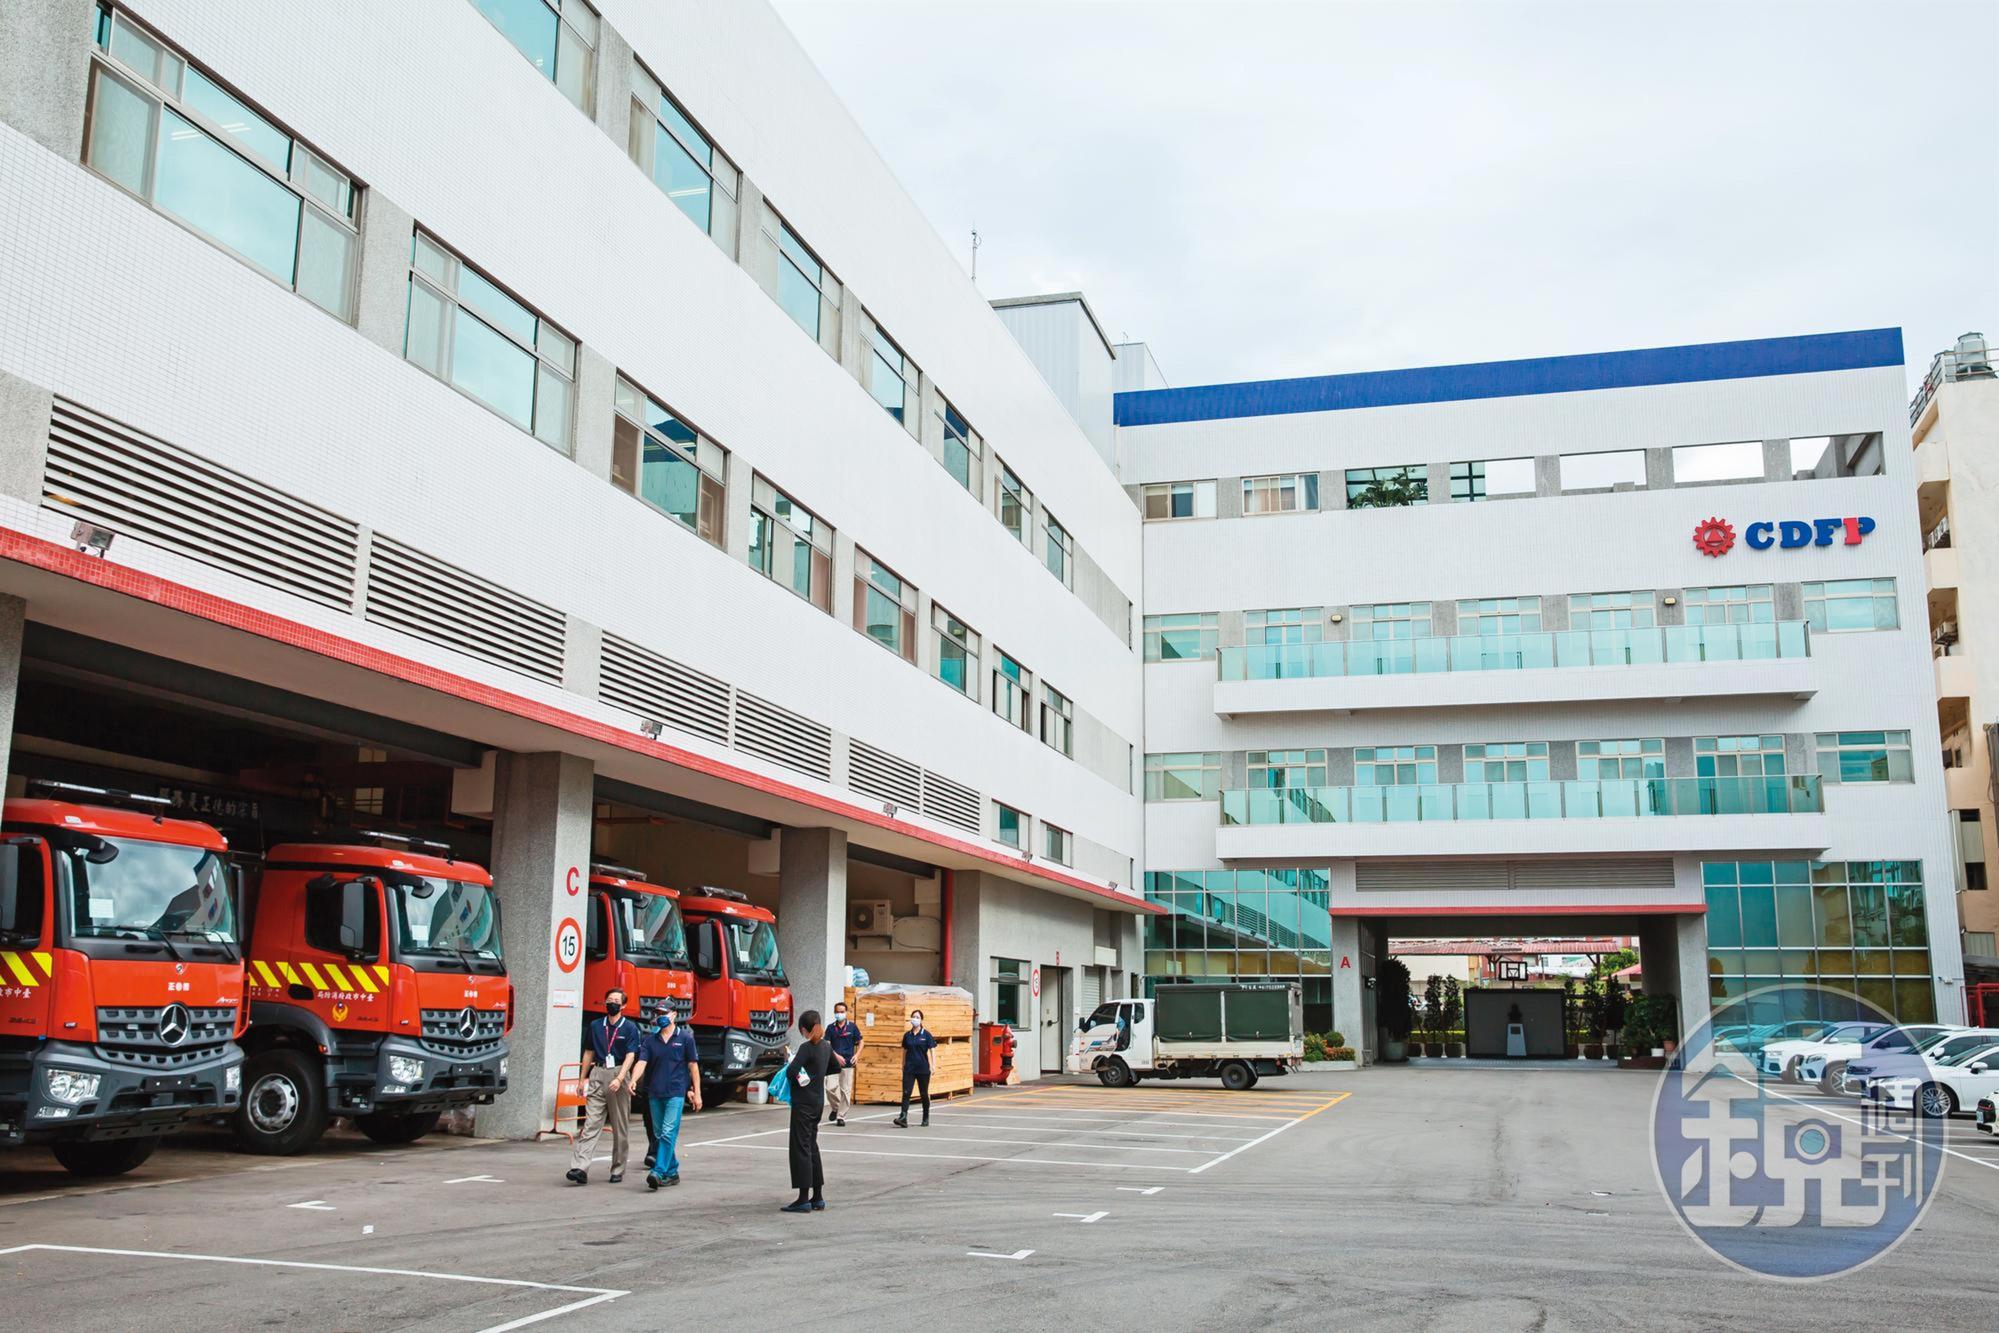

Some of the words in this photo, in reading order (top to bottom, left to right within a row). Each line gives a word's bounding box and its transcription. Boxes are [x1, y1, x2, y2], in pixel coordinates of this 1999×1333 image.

[1745, 516, 1876, 550] CDFP
[566, 866, 580, 897] C
[562, 935, 576, 957] 15
[1340, 955, 1351, 969] A
